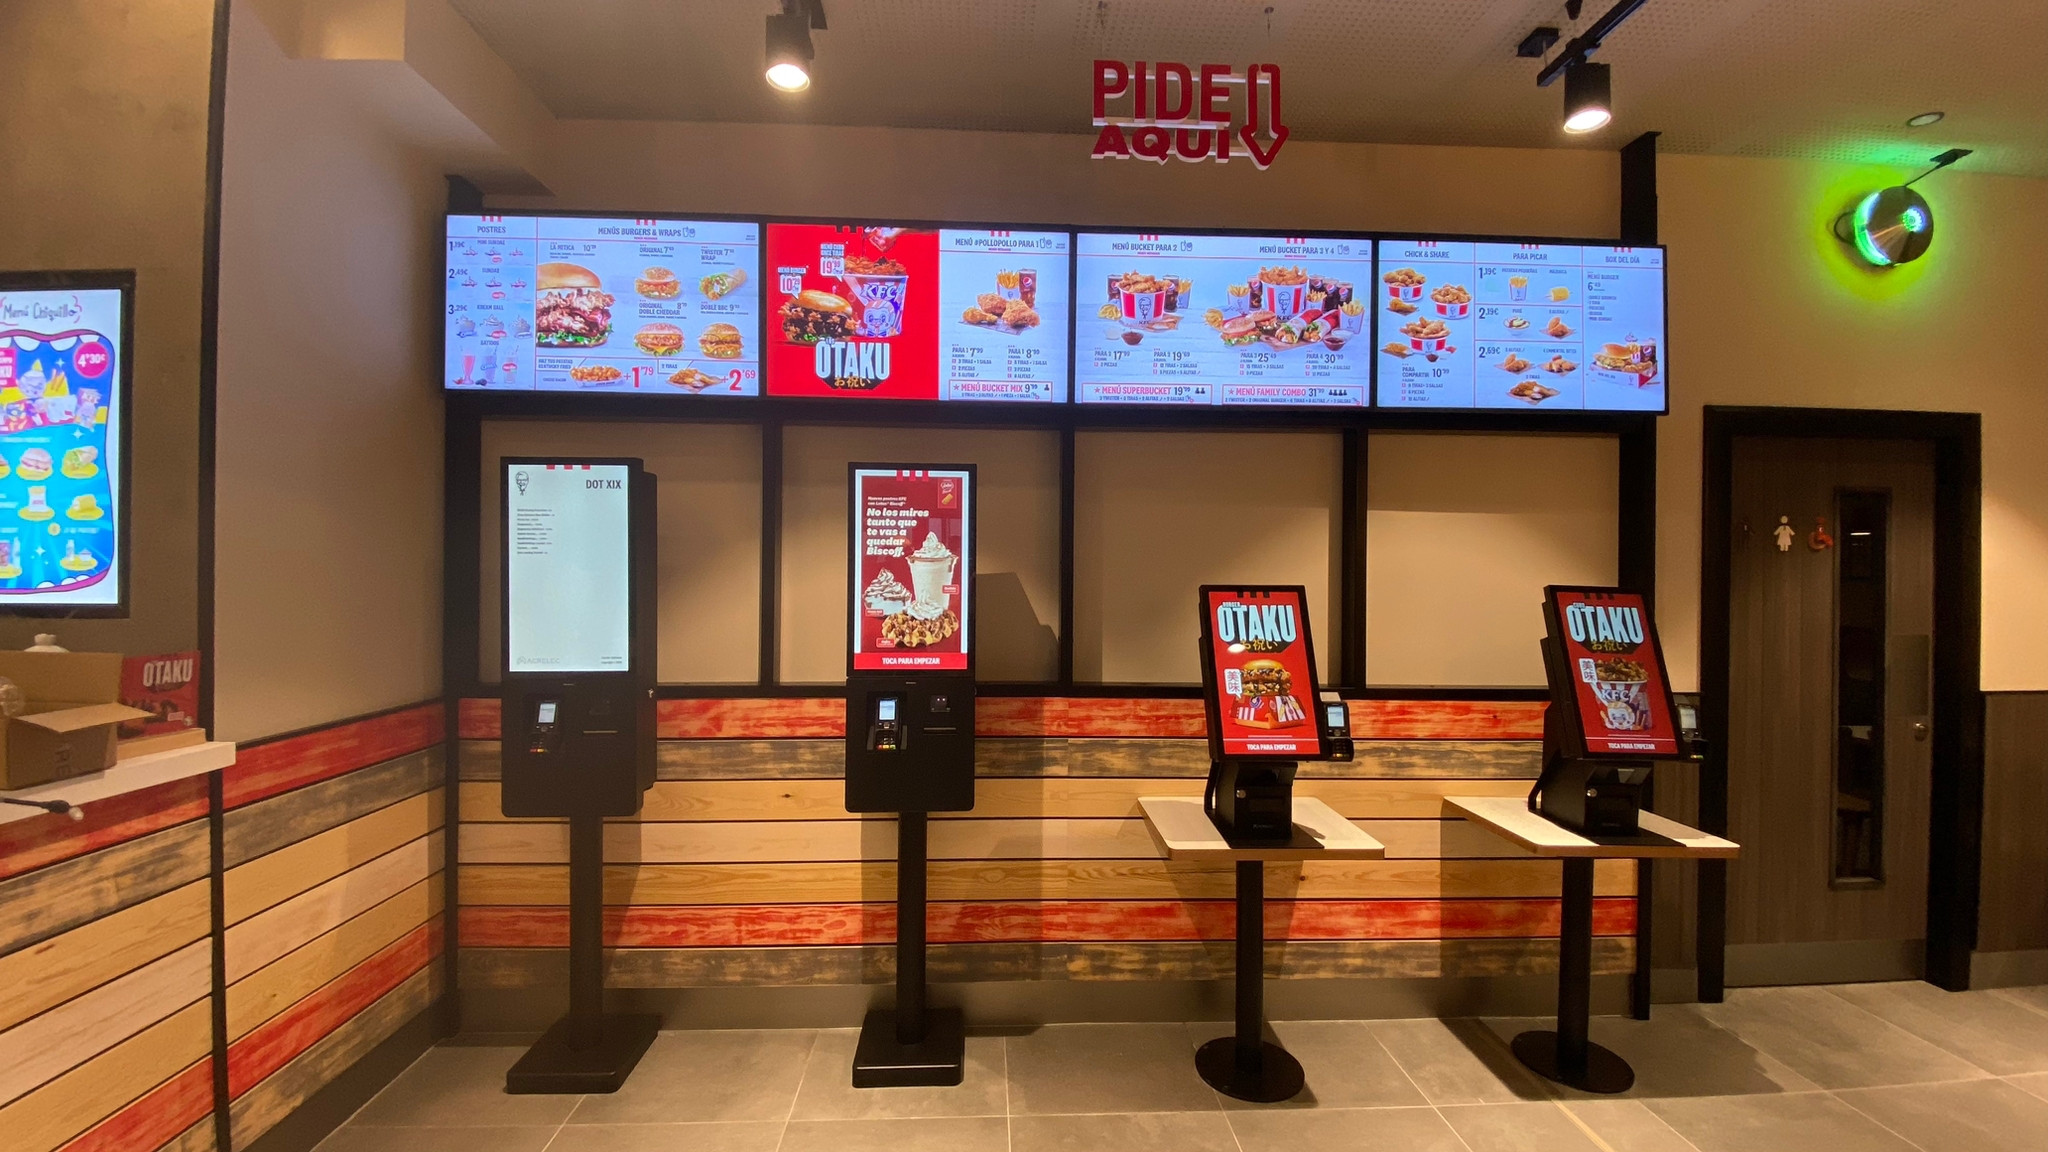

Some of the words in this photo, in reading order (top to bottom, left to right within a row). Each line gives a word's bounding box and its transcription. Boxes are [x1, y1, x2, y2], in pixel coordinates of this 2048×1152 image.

[1093, 60, 1231, 124] PIDE
[477, 226, 506, 234] POSTRES
[598, 226, 620, 236] MENÚS
[621, 228, 651, 236] BURGERS
[658, 229, 682, 237] WRAPS
[955, 237, 973, 246] MENÚ
[975, 239, 1017, 248] #POLLOPOLLO
[1018, 240, 1035, 248] PARA
[1112, 242, 1130, 250] MENÚ
[1131, 243, 1154, 251] BUCKET
[701, 248, 723, 256] TWISTER
[1260, 245, 1276, 253] MENÚ
[1278, 246, 1301, 254] BUCKET
[1404, 250, 1423, 258] CHICK
[1618, 256, 1629, 264] DEL
[1630, 255, 1640, 264] DÍA
[862, 284, 897, 299] KFC
[3, 304, 29, 320] Menú
[33, 303, 76, 322] Chiquillo
[816, 341, 890, 380] OTAKU
[834, 376, 871, 387] お祝い
[961, 382, 980, 392] MENÚ
[982, 384, 1009, 392] BUCKET
[1102, 385, 1121, 394] MENÚ
[1123, 387, 1171, 395] SUPERBUCKET
[1236, 387, 1255, 396] MENÚ
[1256, 388, 1280, 396] FAMILY
[586, 480, 604, 489] DOT
[606, 480, 622, 489] XIX
[866, 508, 882, 517] No
[882, 508, 898, 517] los
[899, 508, 930, 517] mires
[867, 518, 896, 527] tanto
[898, 520, 918, 528] que
[867, 528, 878, 536] te
[866, 537, 905, 547] quedar
[866, 546, 905, 558] Biscoff.
[1217, 605, 1297, 642] OTAKU
[1566, 605, 1644, 644] OTAKU
[143, 659, 193, 687] OTAKU
[1601, 690, 1631, 701] KFC
